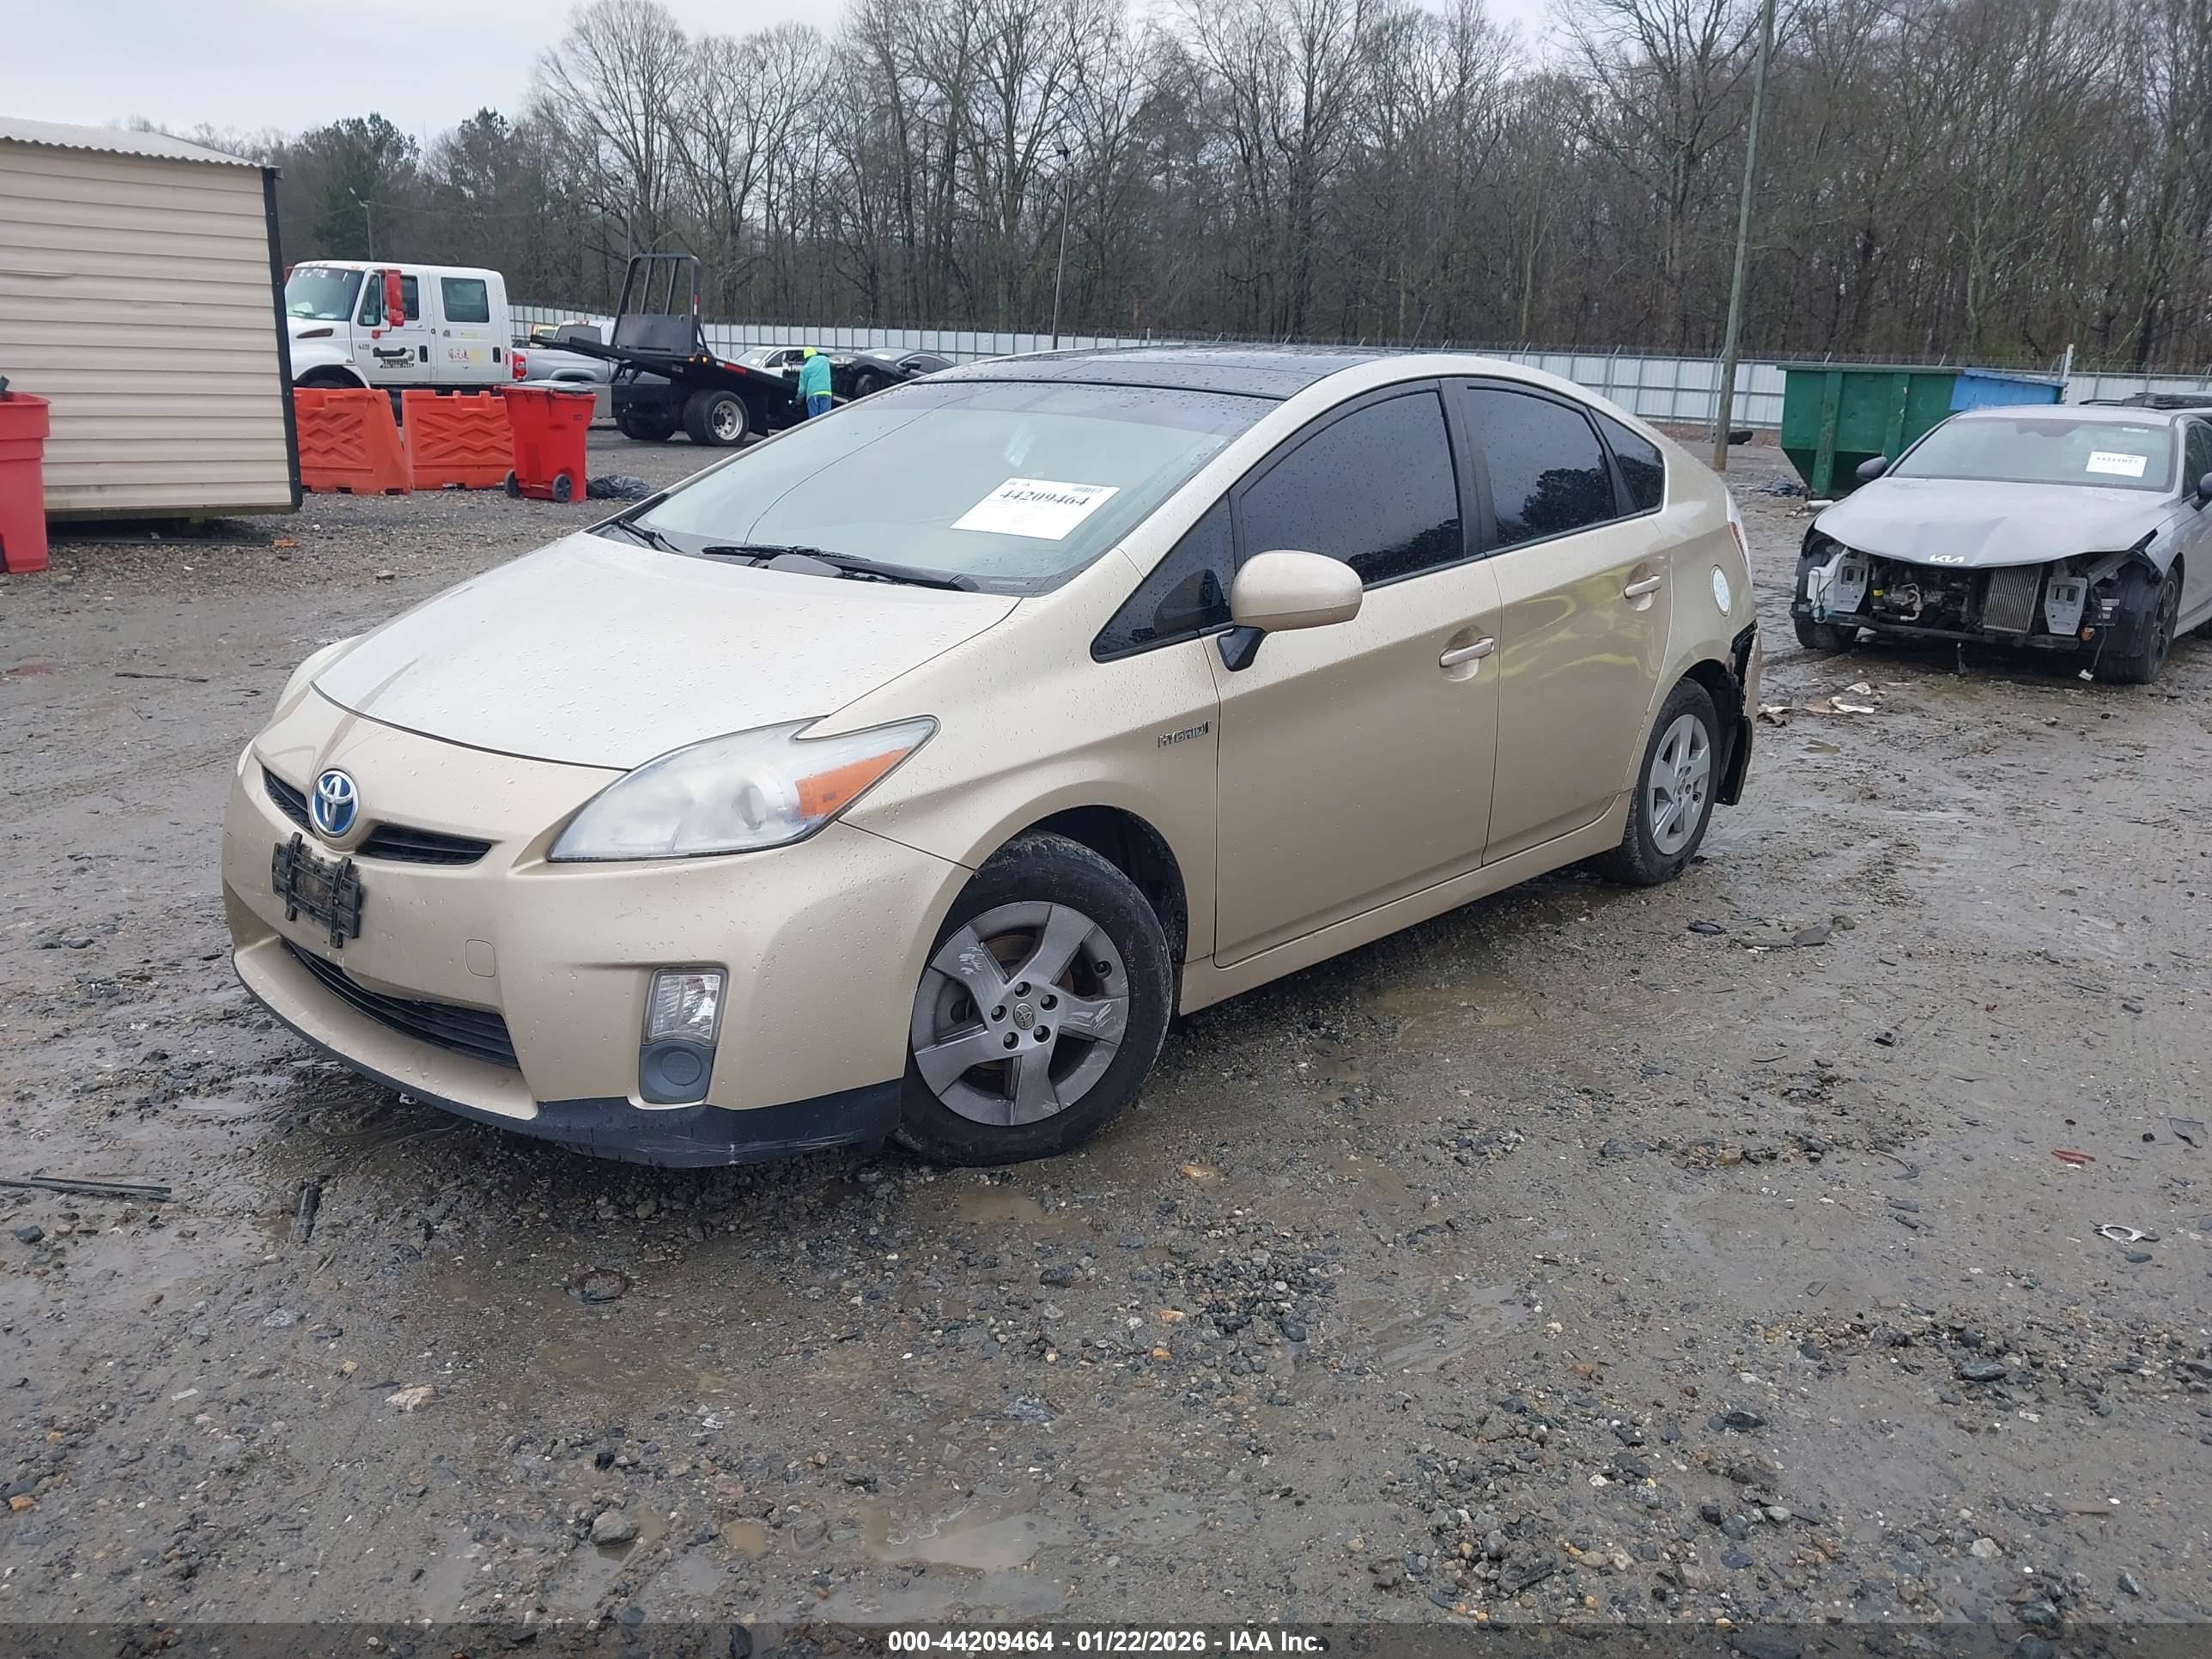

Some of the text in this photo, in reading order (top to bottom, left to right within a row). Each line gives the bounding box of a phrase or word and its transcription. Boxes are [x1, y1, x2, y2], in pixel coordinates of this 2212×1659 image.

[999, 489, 1091, 507] 44209464
[1929, 553, 1965, 563] KIA
[1158, 720, 1210, 749] HYBRID
